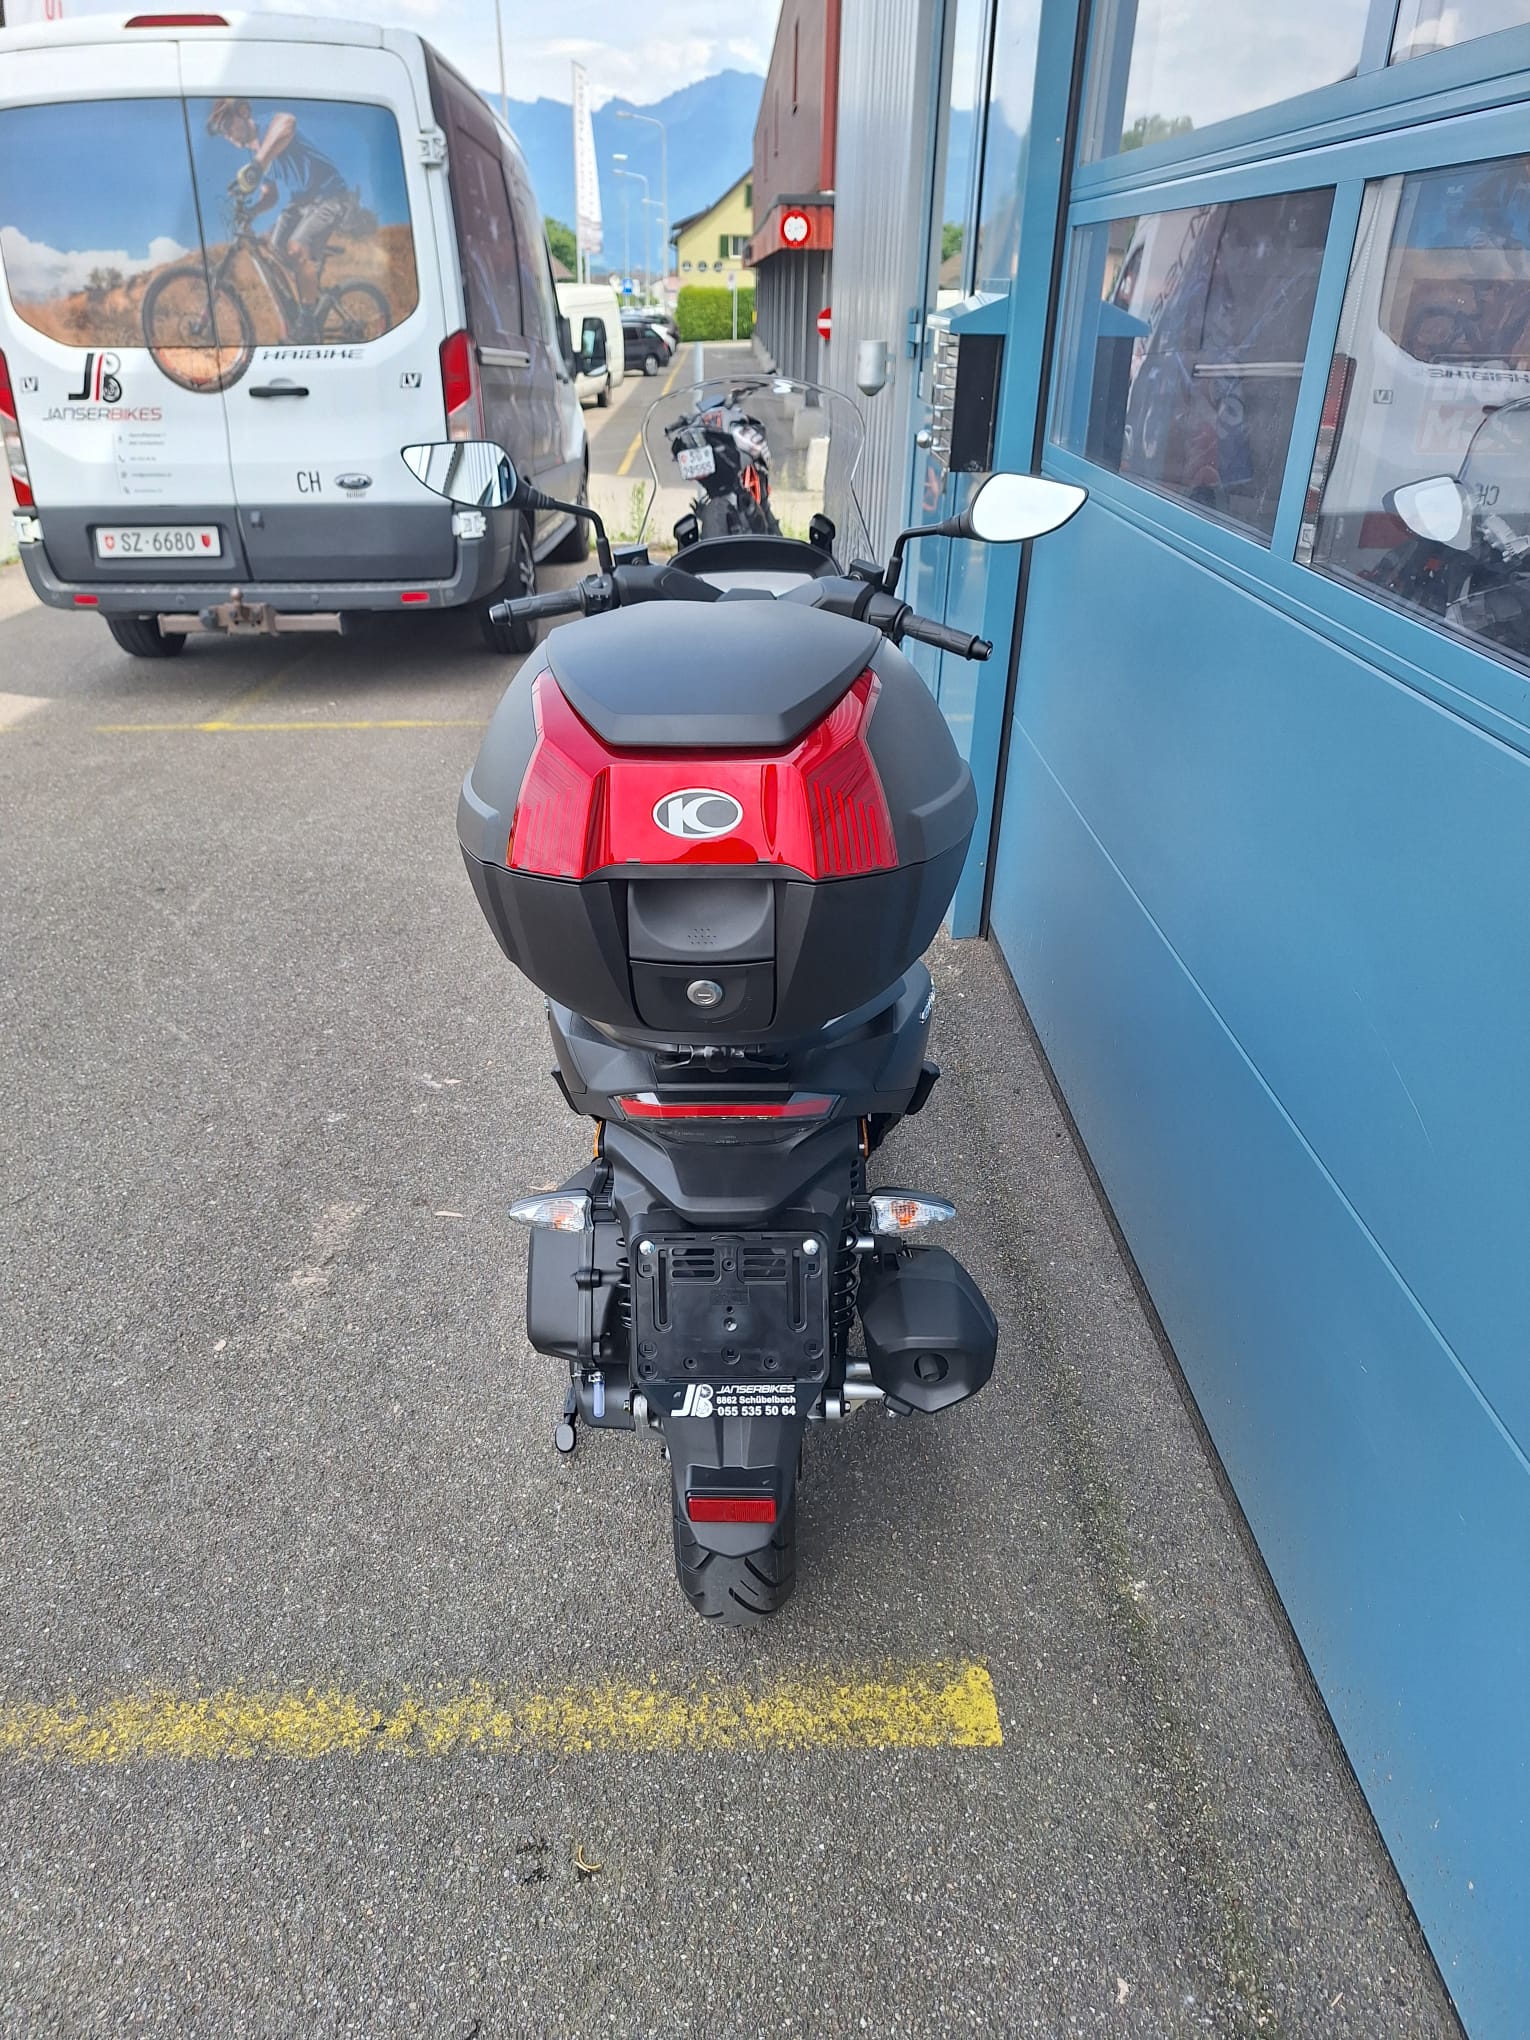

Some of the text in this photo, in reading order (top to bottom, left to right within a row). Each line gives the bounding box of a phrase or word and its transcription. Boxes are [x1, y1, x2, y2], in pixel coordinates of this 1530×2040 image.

[263, 349, 364, 360] HAIBIKE
[42, 407, 162, 421] JANSERBIKES
[296, 470, 322, 493] CH
[716, 1385, 795, 1394] JANSERBIKES
[716, 1395, 796, 1405] 8862 Schübelbach
[717, 1406, 796, 1417] 055 535 50 64
